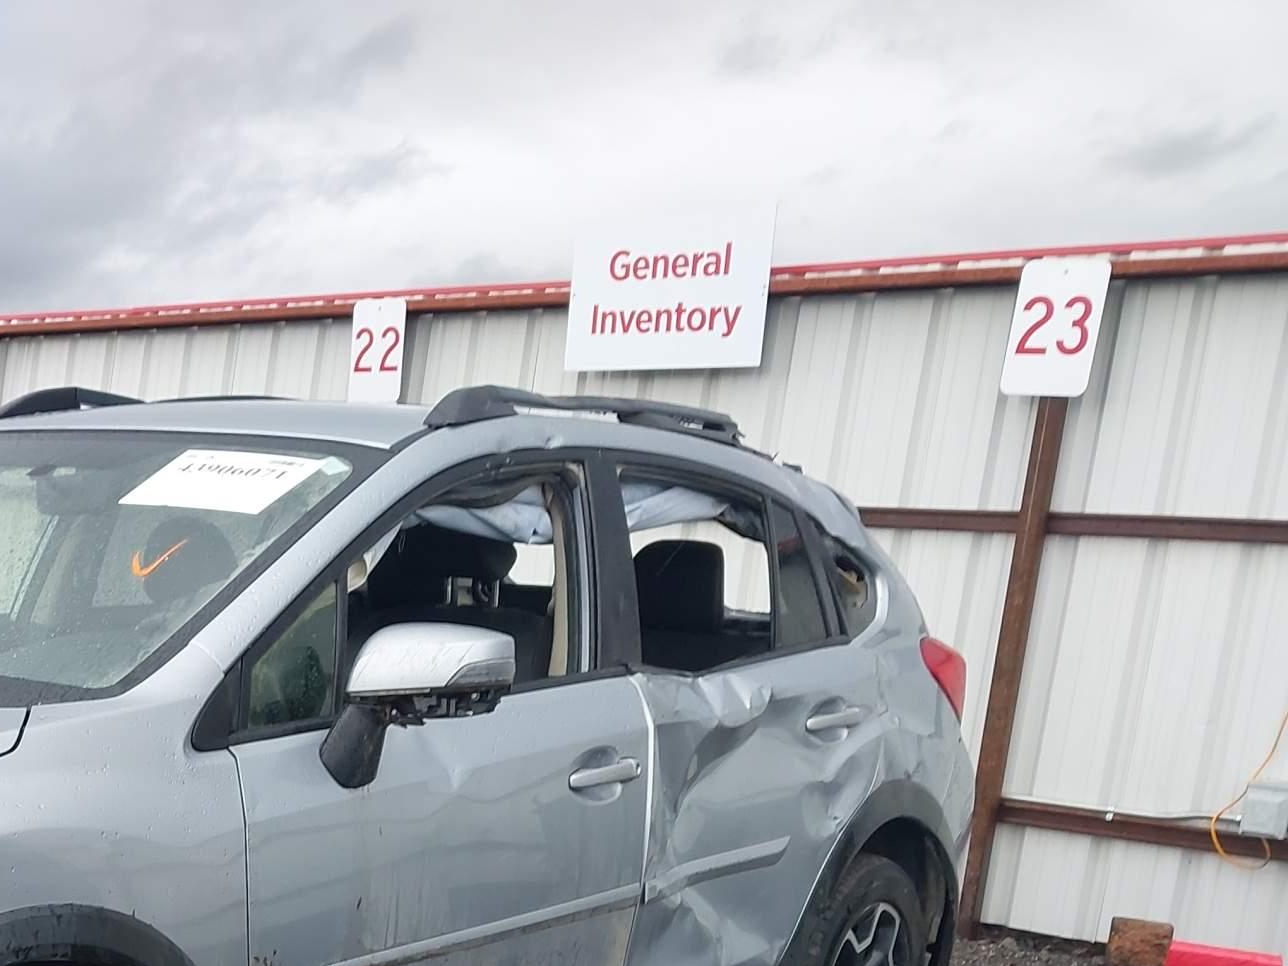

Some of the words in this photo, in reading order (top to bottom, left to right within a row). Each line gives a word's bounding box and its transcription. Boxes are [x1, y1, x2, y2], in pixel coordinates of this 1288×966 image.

[609, 242, 733, 281] General
[591, 303, 742, 337] Inventory
[1015, 294, 1093, 357] 23
[353, 326, 401, 374] 22
